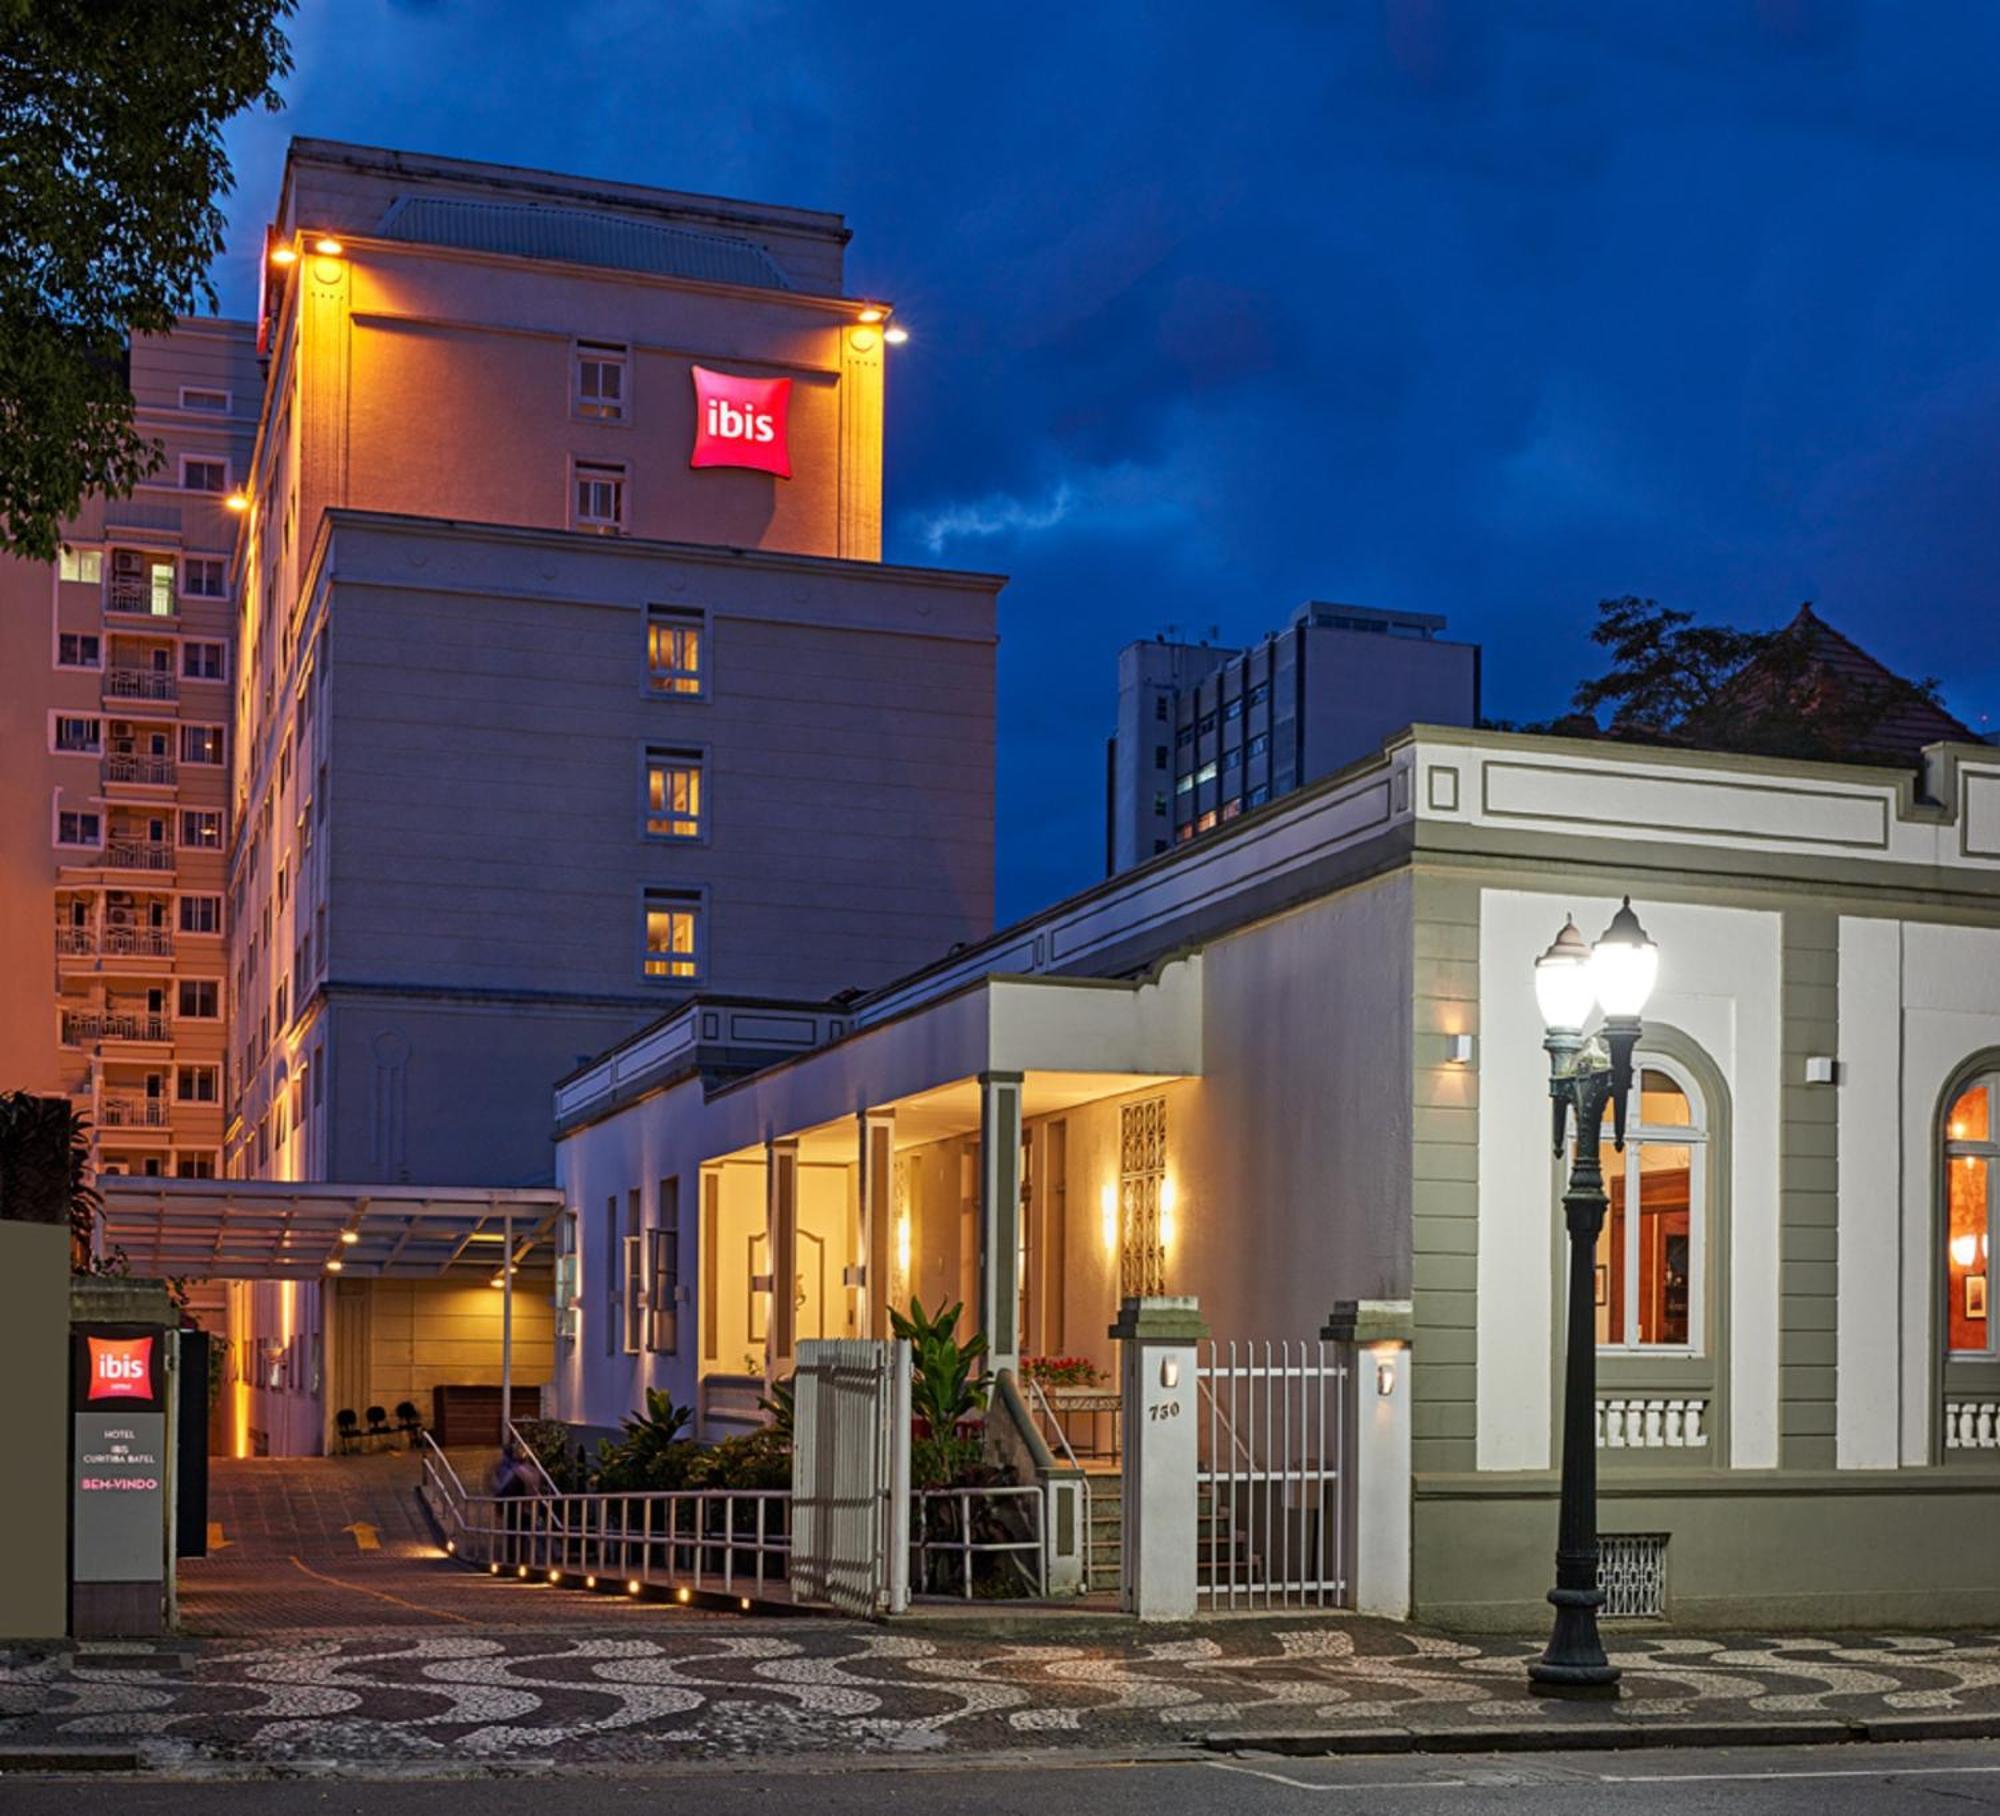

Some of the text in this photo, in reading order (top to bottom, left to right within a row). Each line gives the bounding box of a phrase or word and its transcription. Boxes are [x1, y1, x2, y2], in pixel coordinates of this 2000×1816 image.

[708, 399, 774, 442] ibis
[100, 1354, 143, 1378] ibis
[104, 1430, 135, 1439] HOTEL
[82, 1479, 158, 1489] BEM-VINDO
